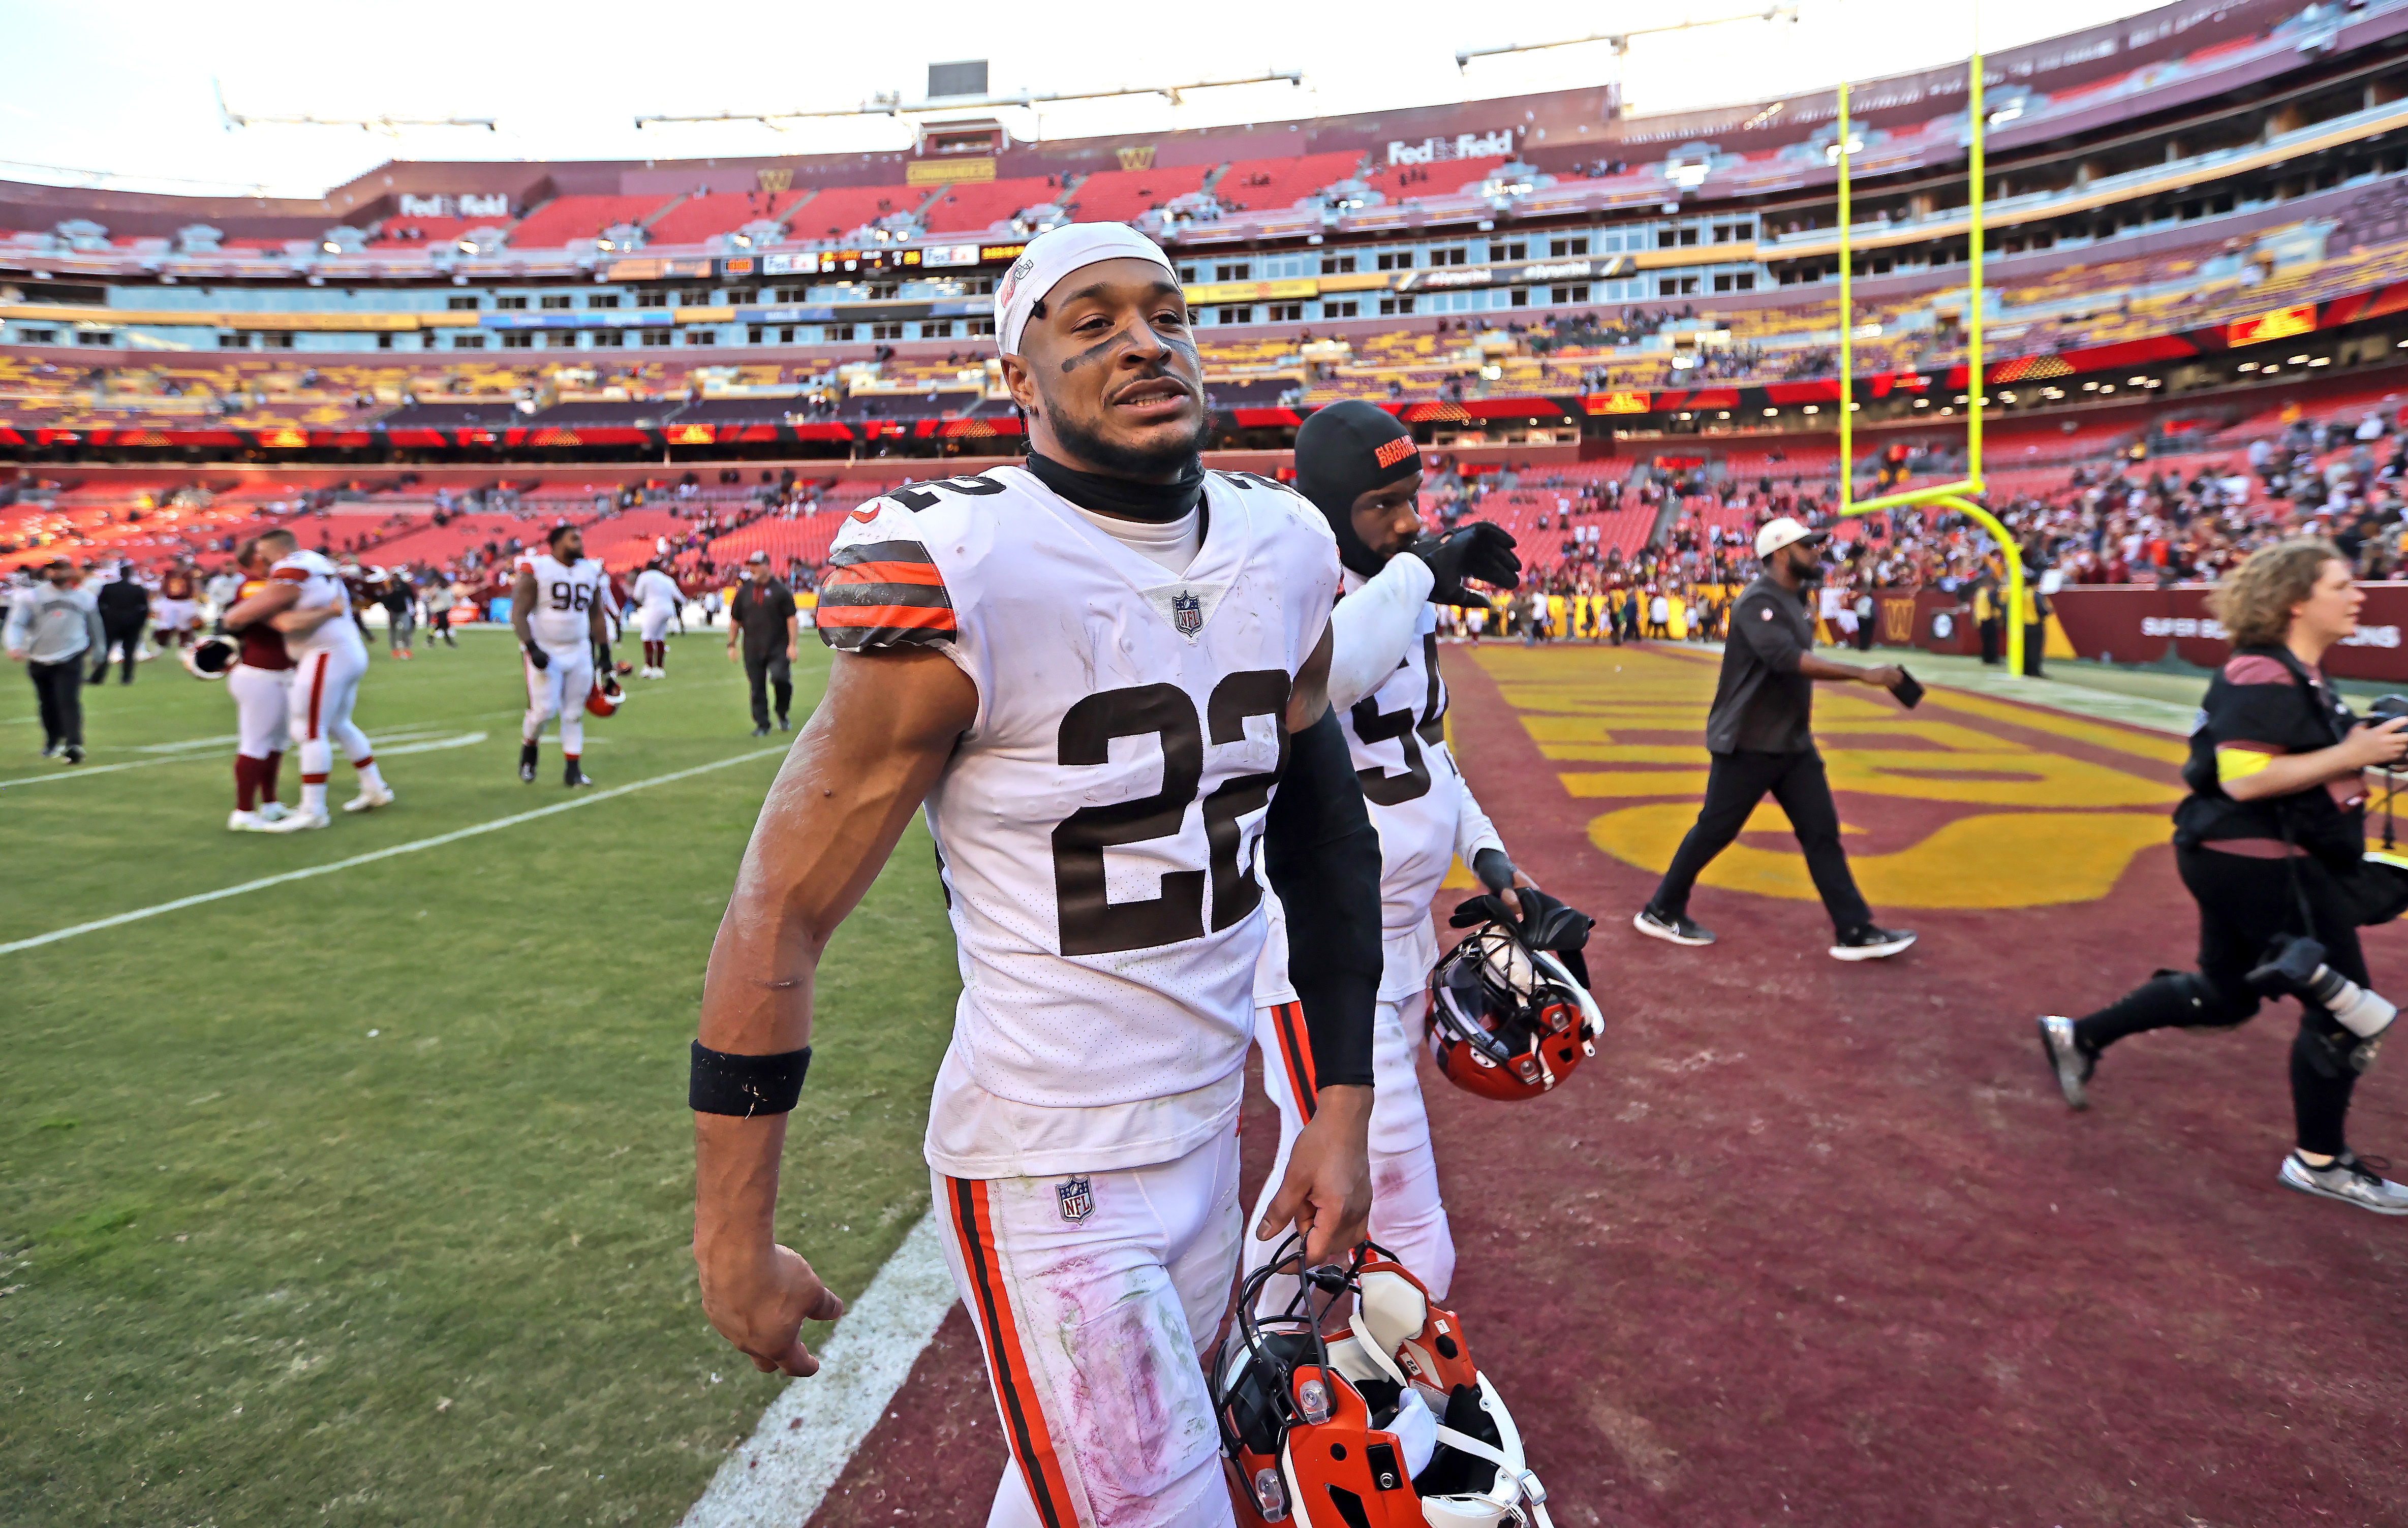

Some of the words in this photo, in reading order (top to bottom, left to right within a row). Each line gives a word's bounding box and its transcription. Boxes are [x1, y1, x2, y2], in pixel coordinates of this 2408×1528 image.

[551, 582, 591, 611] 96
[1179, 611, 1200, 628] NFL
[2141, 617, 2197, 637] SUPER
[1052, 669, 1291, 956] 22
[1064, 1195, 1090, 1215] NFL
